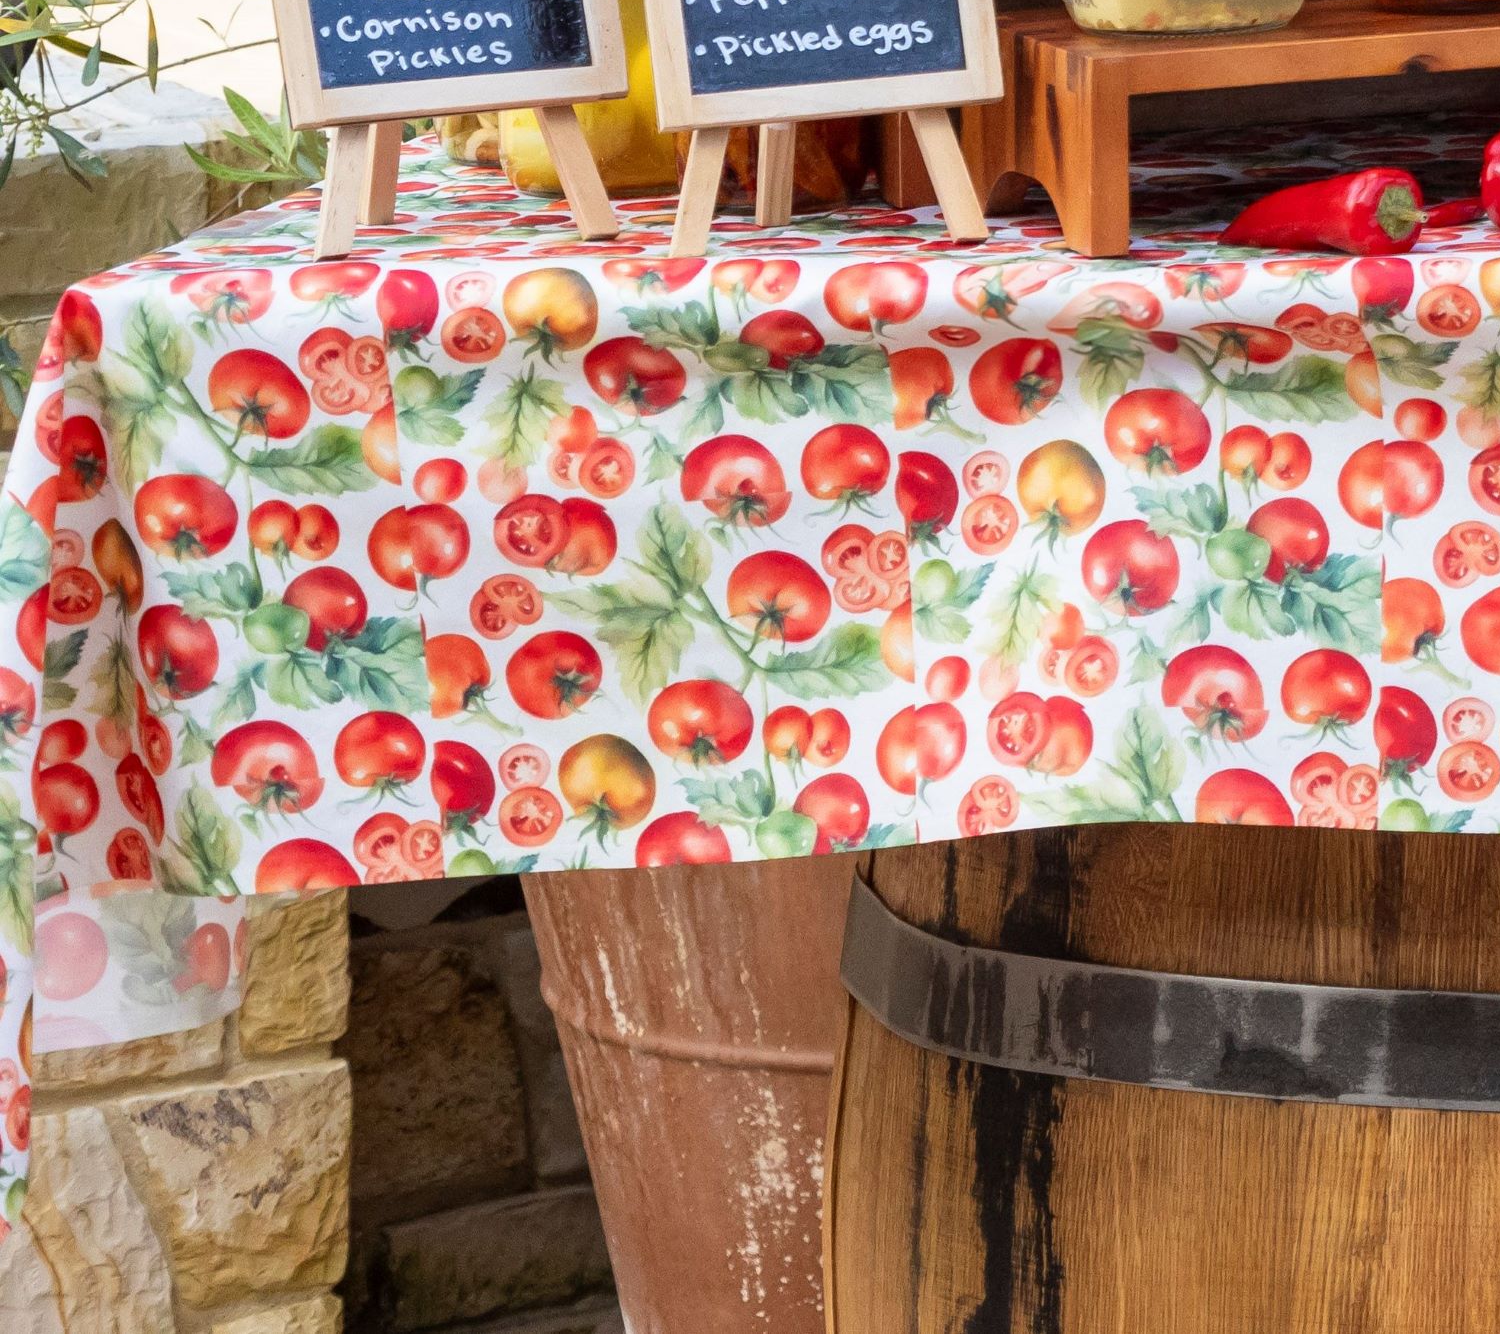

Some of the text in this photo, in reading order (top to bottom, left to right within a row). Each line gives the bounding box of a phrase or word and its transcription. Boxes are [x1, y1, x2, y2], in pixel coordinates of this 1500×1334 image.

[336, 9, 513, 42] Cornison
[713, 20, 933, 65] Pickled eggs
[367, 41, 513, 76] Pickles
